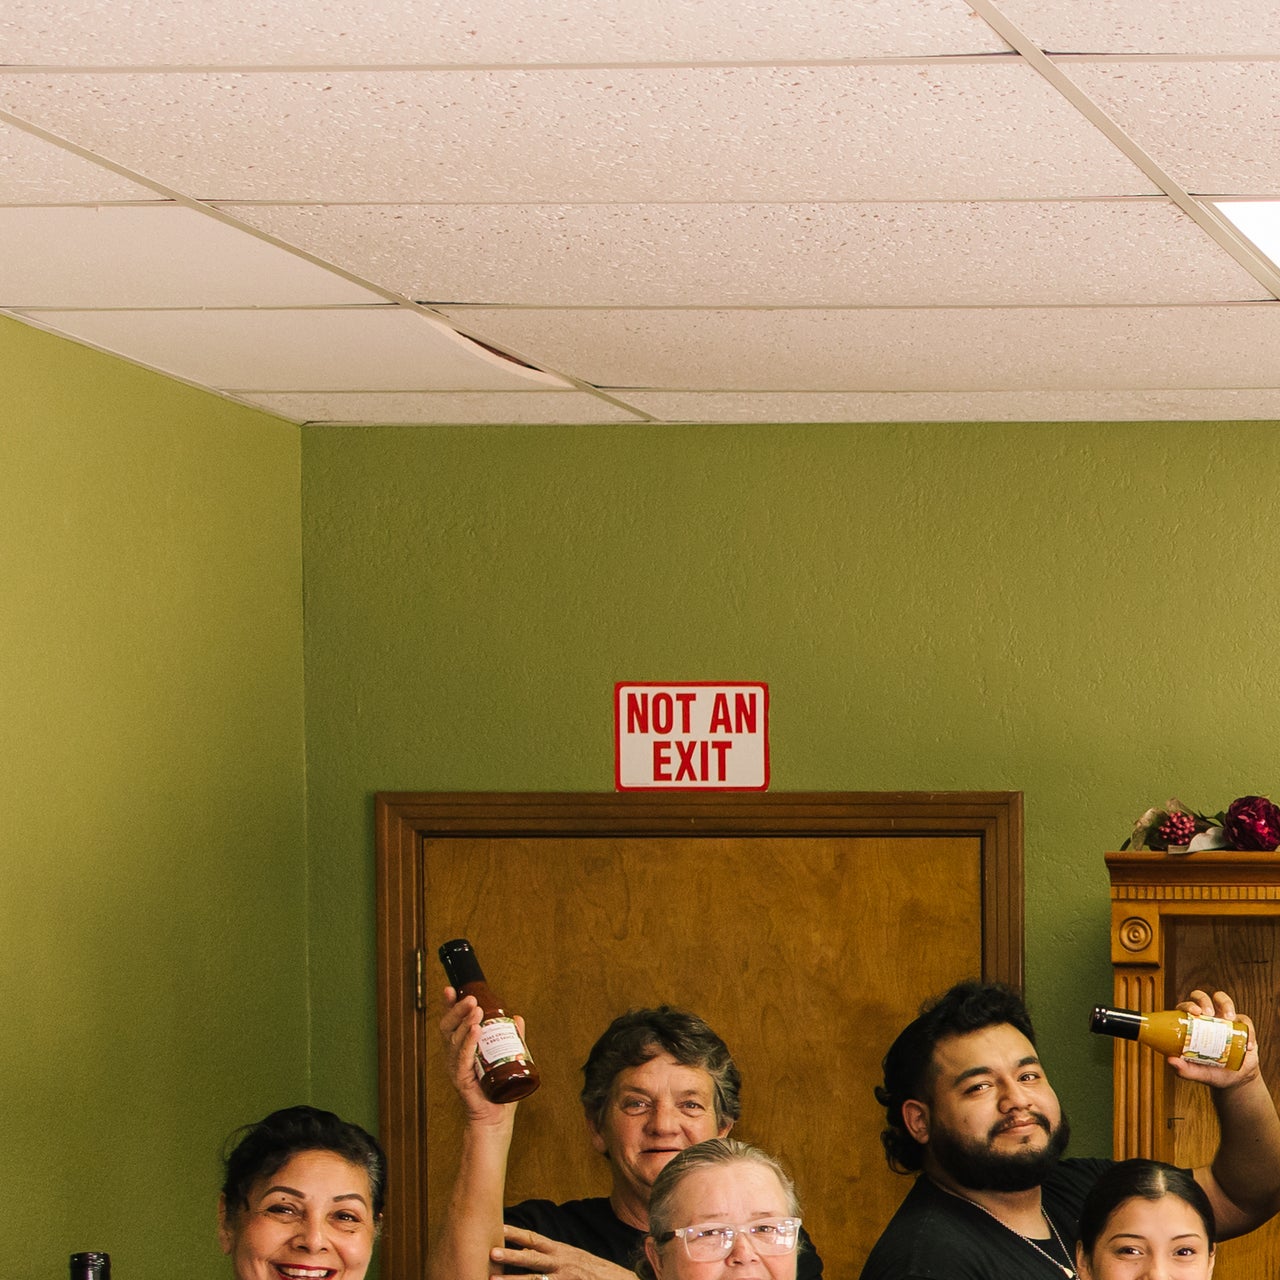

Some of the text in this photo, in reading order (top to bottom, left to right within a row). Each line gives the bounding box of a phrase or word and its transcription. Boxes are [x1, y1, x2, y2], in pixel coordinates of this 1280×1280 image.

[627, 692, 757, 734] NOT AN
[653, 741, 732, 781] EXIT
